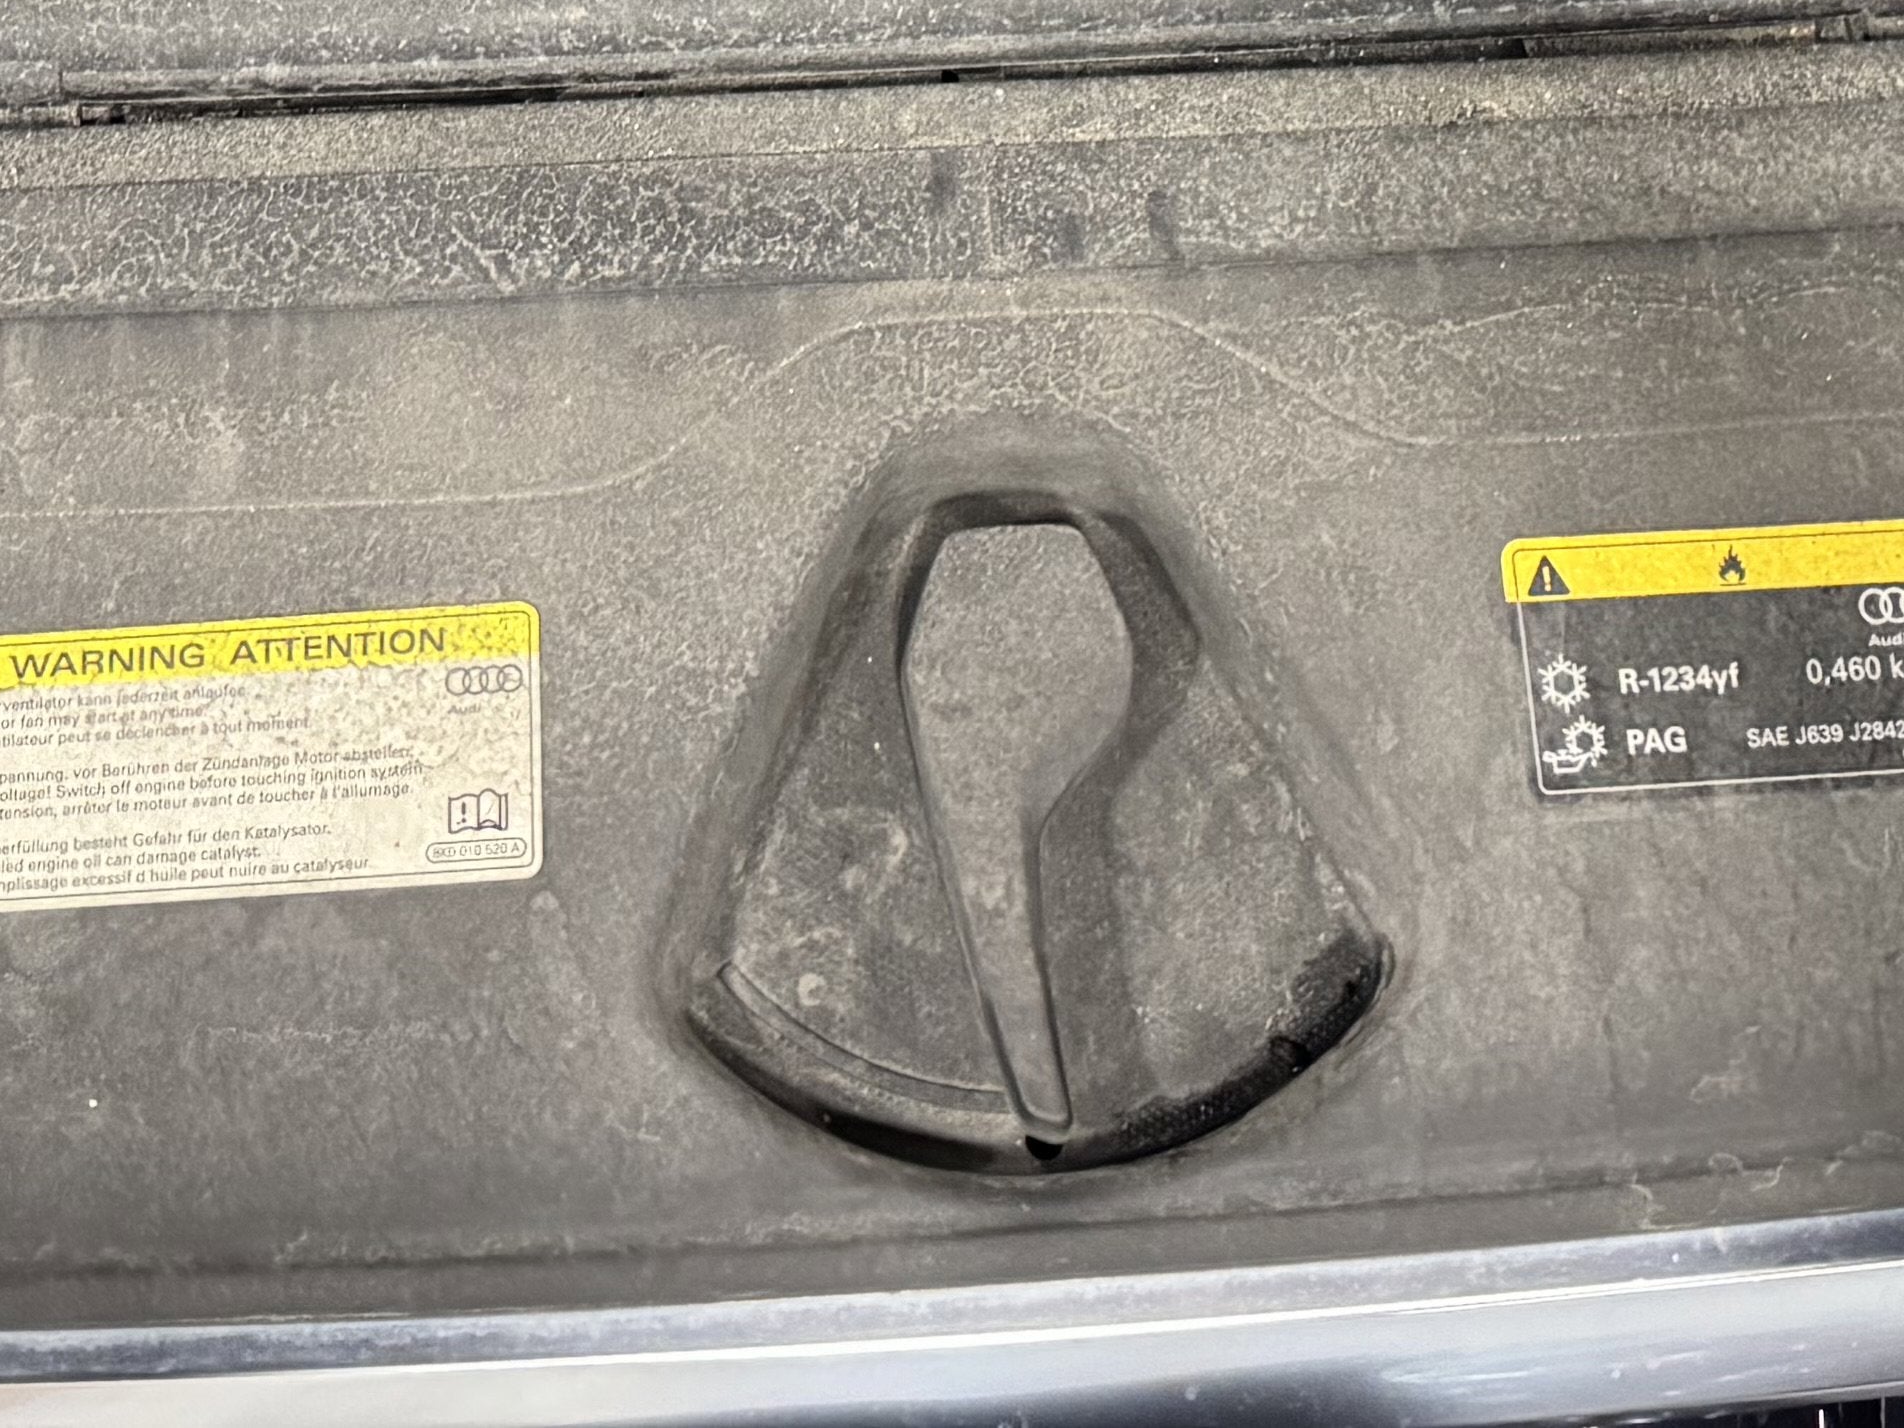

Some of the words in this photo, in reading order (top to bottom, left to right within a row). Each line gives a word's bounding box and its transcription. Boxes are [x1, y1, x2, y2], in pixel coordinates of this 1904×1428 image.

[9, 642, 206, 679] WARNING
[229, 626, 448, 665] ATTENTION
[1618, 663, 1740, 697] R-1234yf
[1806, 655, 1881, 686] 0,460
[76, 692, 111, 707] kann
[20, 714, 43, 728] fan
[48, 714, 80, 728] may
[57, 730, 90, 745] peut
[94, 731, 110, 741] se
[213, 721, 242, 734] tout
[1746, 726, 1789, 747] SAE
[1794, 723, 1843, 744] J639
[1626, 727, 1686, 754] PAG
[73, 767, 97, 778] vor
[101, 760, 170, 776] Berühren
[173, 759, 198, 772] der
[201, 753, 289, 772] Zündanlage
[293, 750, 338, 765] Motor
[55, 782, 105, 798] Switch
[110, 780, 131, 794] off
[134, 779, 185, 794] engine
[189, 774, 236, 789] before
[241, 770, 305, 787] touching
[310, 766, 365, 783] ignition
[0, 805, 58, 820] tension,
[62, 800, 111, 815] arrêter
[116, 799, 128, 812] le
[133, 797, 187, 810] moteur
[192, 794, 232, 807] avant
[236, 791, 254, 804] de
[259, 788, 314, 803] toucher
[73, 834, 127, 850] besteht
[132, 830, 182, 846] Gefahr
[187, 829, 207, 843] für
[212, 827, 240, 841] den
[244, 821, 332, 841] Katalysator.
[459, 845, 481, 855] 010
[510, 842, 520, 851] A
[28, 855, 78, 874] engine
[82, 854, 101, 867] oil
[105, 855, 131, 866] can
[136, 848, 196, 867] damage
[200, 844, 261, 862] catalyst.
[71, 870, 132, 886] excessif
[191, 865, 224, 881] peut
[229, 863, 266, 876] nuire
[271, 864, 288, 873] au
